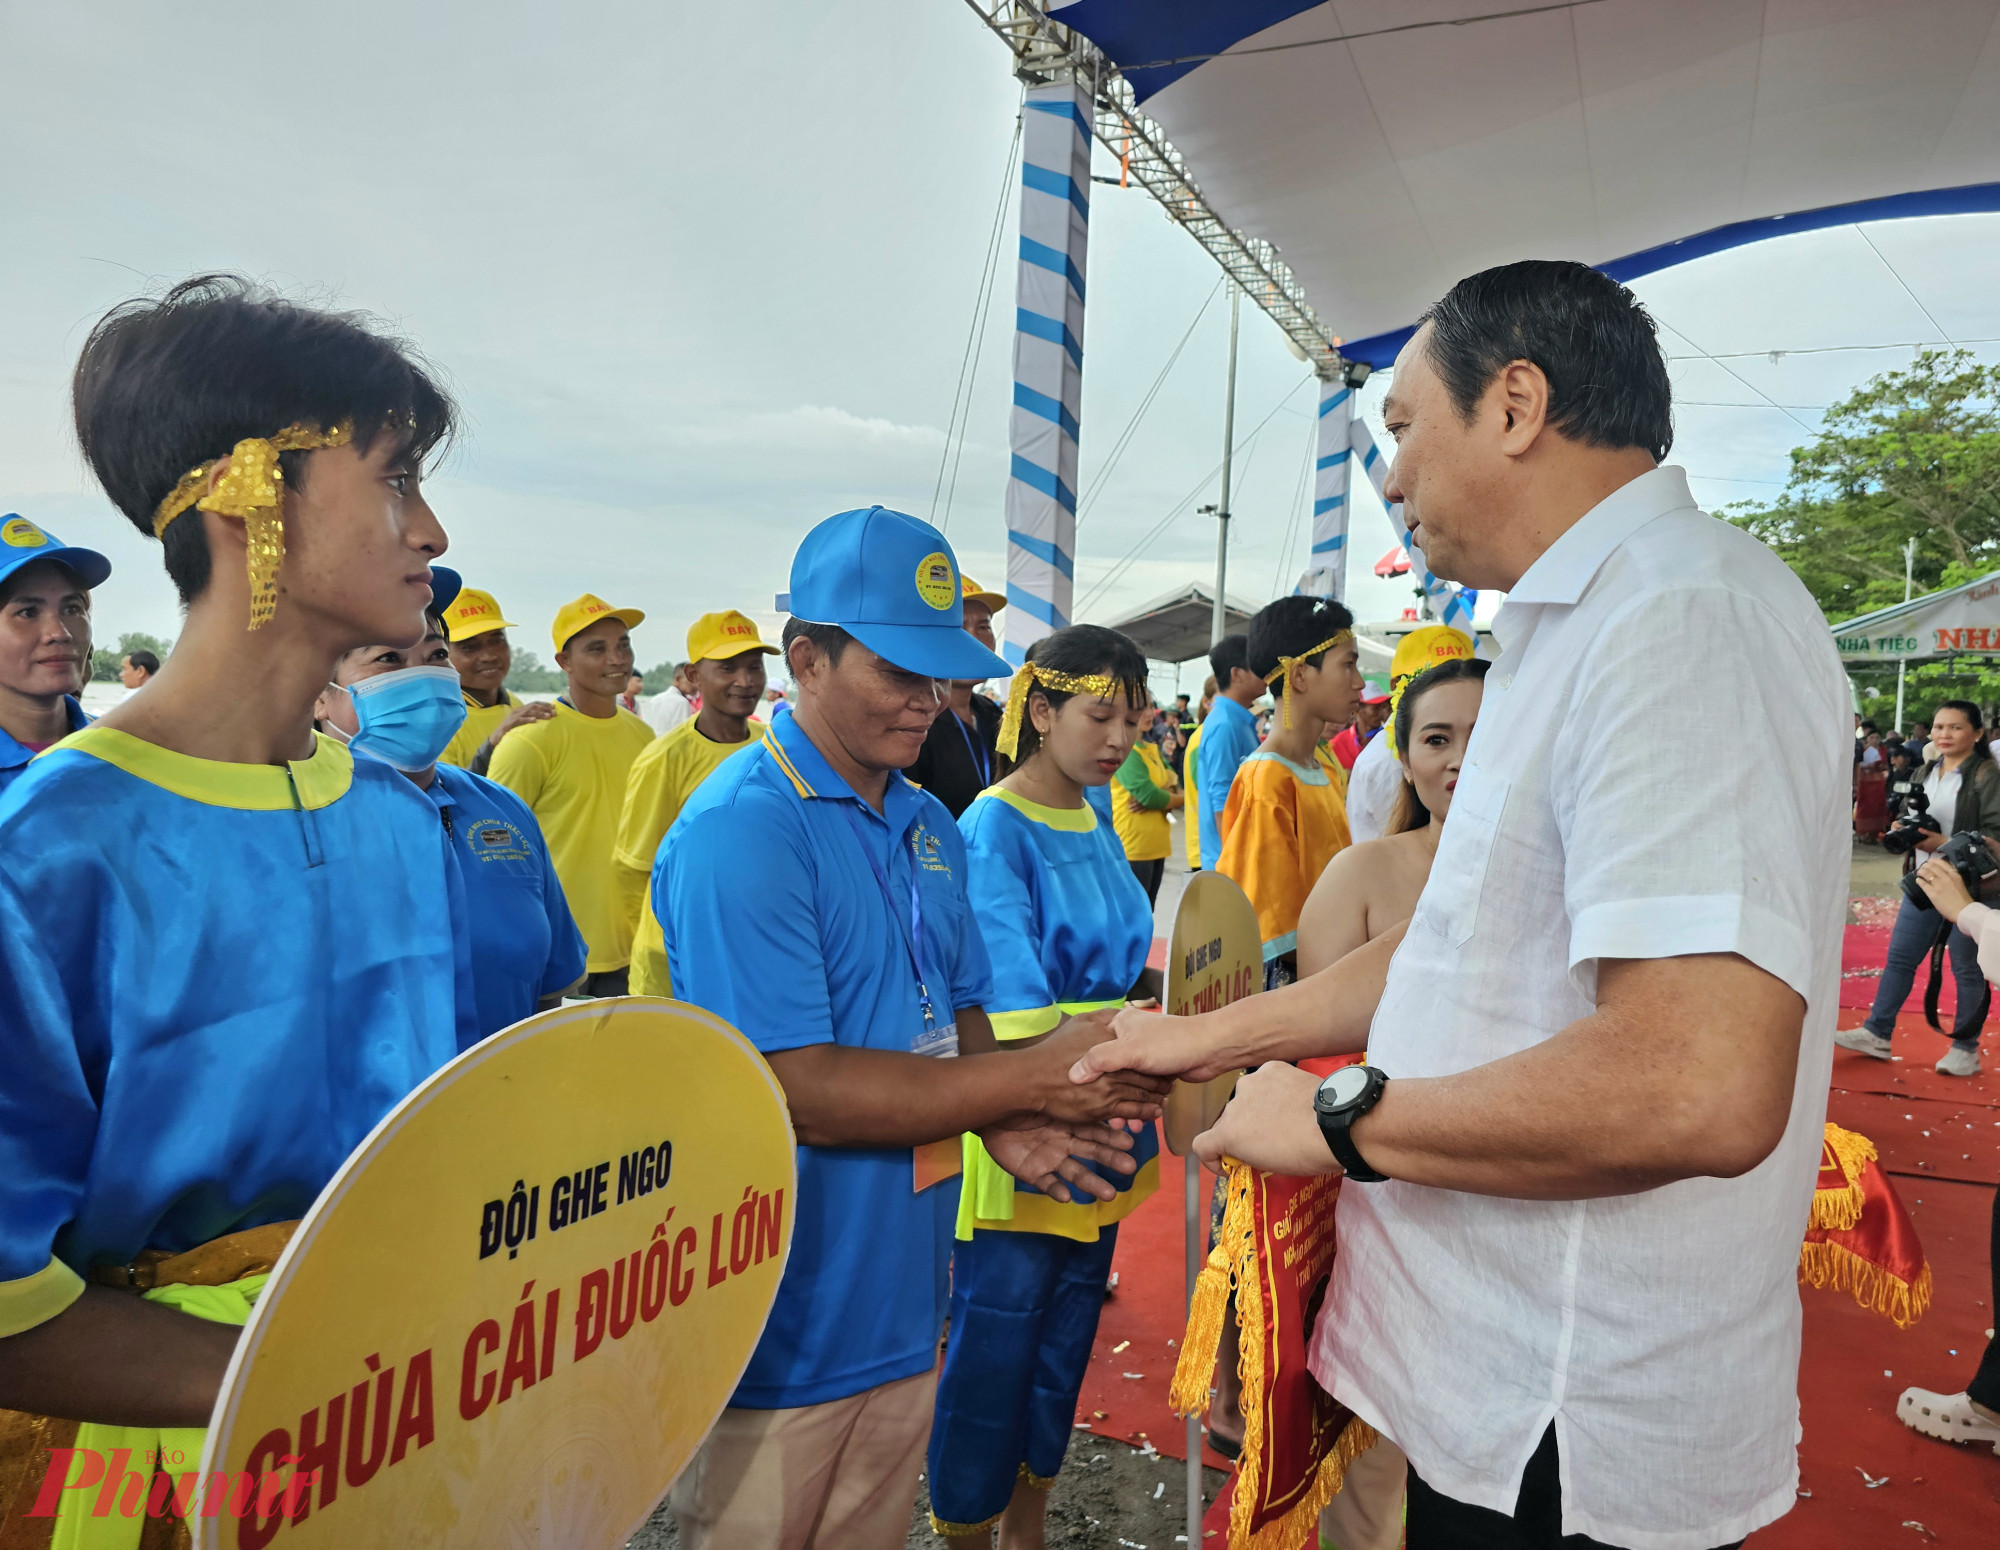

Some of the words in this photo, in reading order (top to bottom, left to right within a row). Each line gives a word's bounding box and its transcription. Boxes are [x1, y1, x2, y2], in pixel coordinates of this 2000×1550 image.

[1185, 946, 1196, 982] ĐỘI
[1196, 943, 1208, 973] GHE
[1208, 936, 1222, 965] NGO
[478, 1178, 540, 1261] ĐỘI
[548, 1160, 611, 1232] GHE
[616, 1139, 673, 1207] NGO
[237, 1347, 435, 1550] CHÙA
[458, 1278, 561, 1421] CÁI
[573, 1205, 698, 1364] ĐUỐC
[707, 1184, 785, 1290] LỚN
